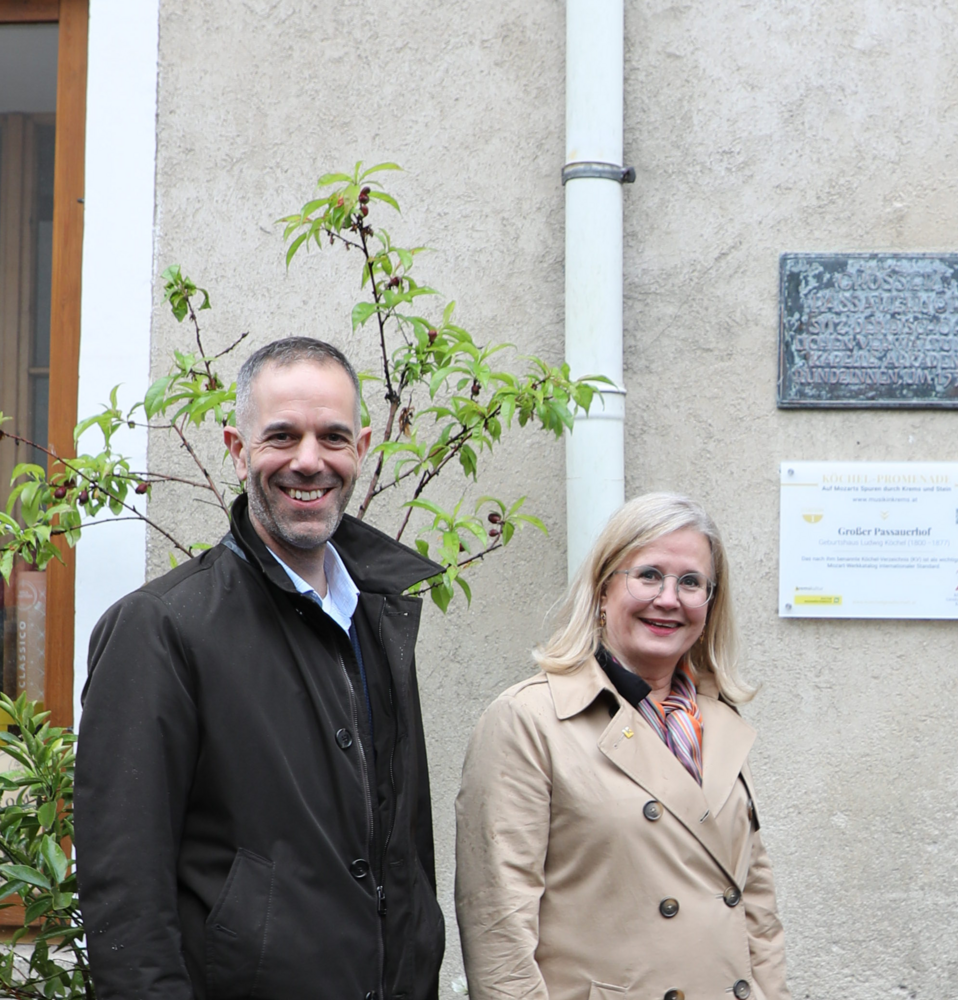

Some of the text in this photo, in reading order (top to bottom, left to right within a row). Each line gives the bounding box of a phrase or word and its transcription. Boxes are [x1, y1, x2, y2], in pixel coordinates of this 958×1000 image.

[822, 473, 950, 484] KÖCHEL-PROMENADE
[859, 486, 882, 494] Spuren
[837, 526, 932, 536] Großer Passauerhof
[860, 539, 883, 548] Ludwig
[884, 538, 906, 546] Köchel
[908, 539, 926, 548] (1800
[932, 539, 950, 548] 1877)
[19, 621, 27, 689] CLASSICO
